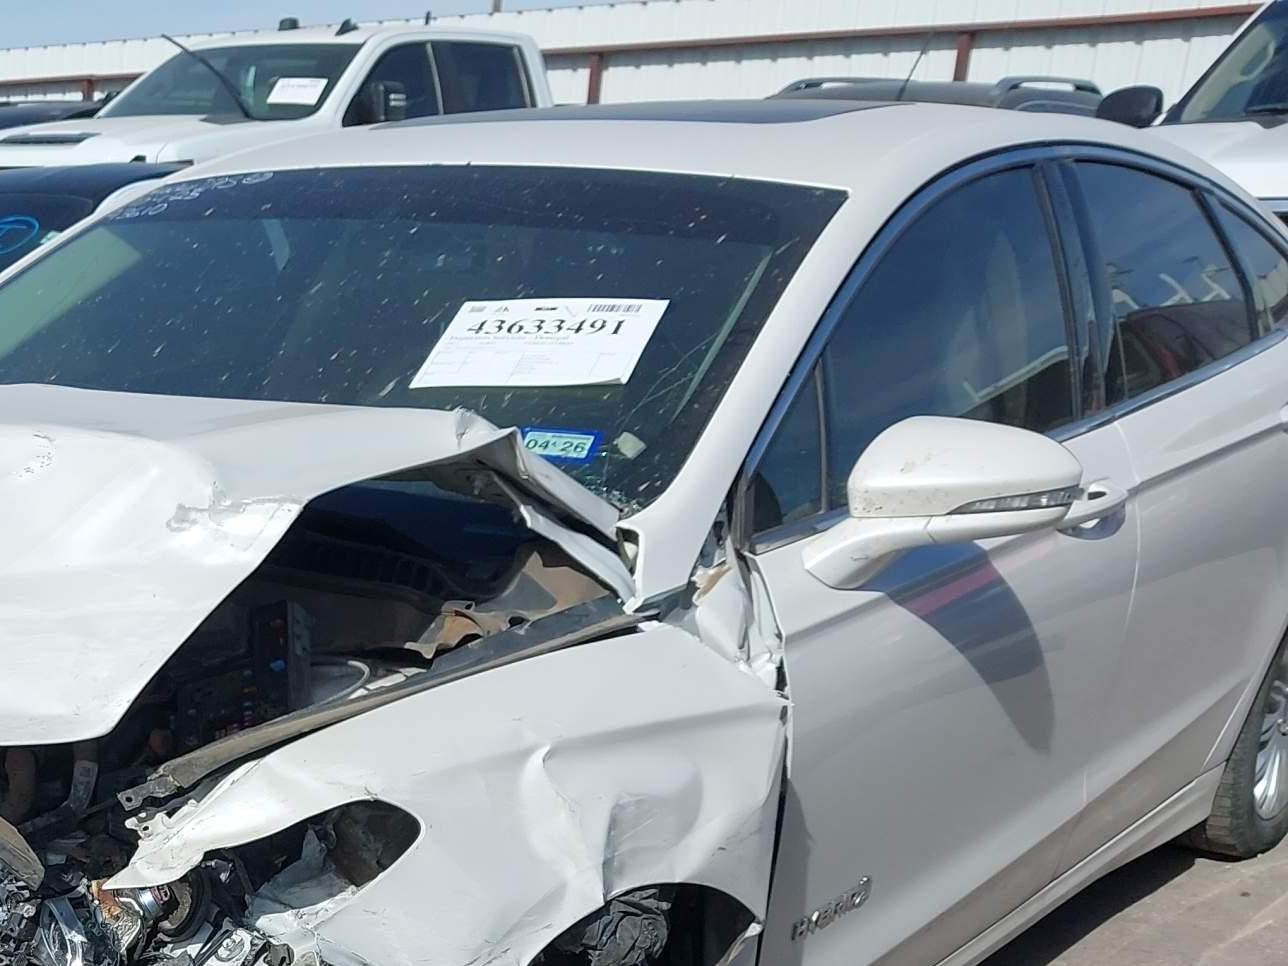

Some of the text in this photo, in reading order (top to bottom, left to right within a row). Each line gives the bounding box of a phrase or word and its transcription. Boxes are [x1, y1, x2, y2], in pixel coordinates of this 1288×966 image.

[466, 318, 627, 336] 43633491
[526, 438, 587, 453] 04 26
[791, 886, 870, 942] HYBRID
